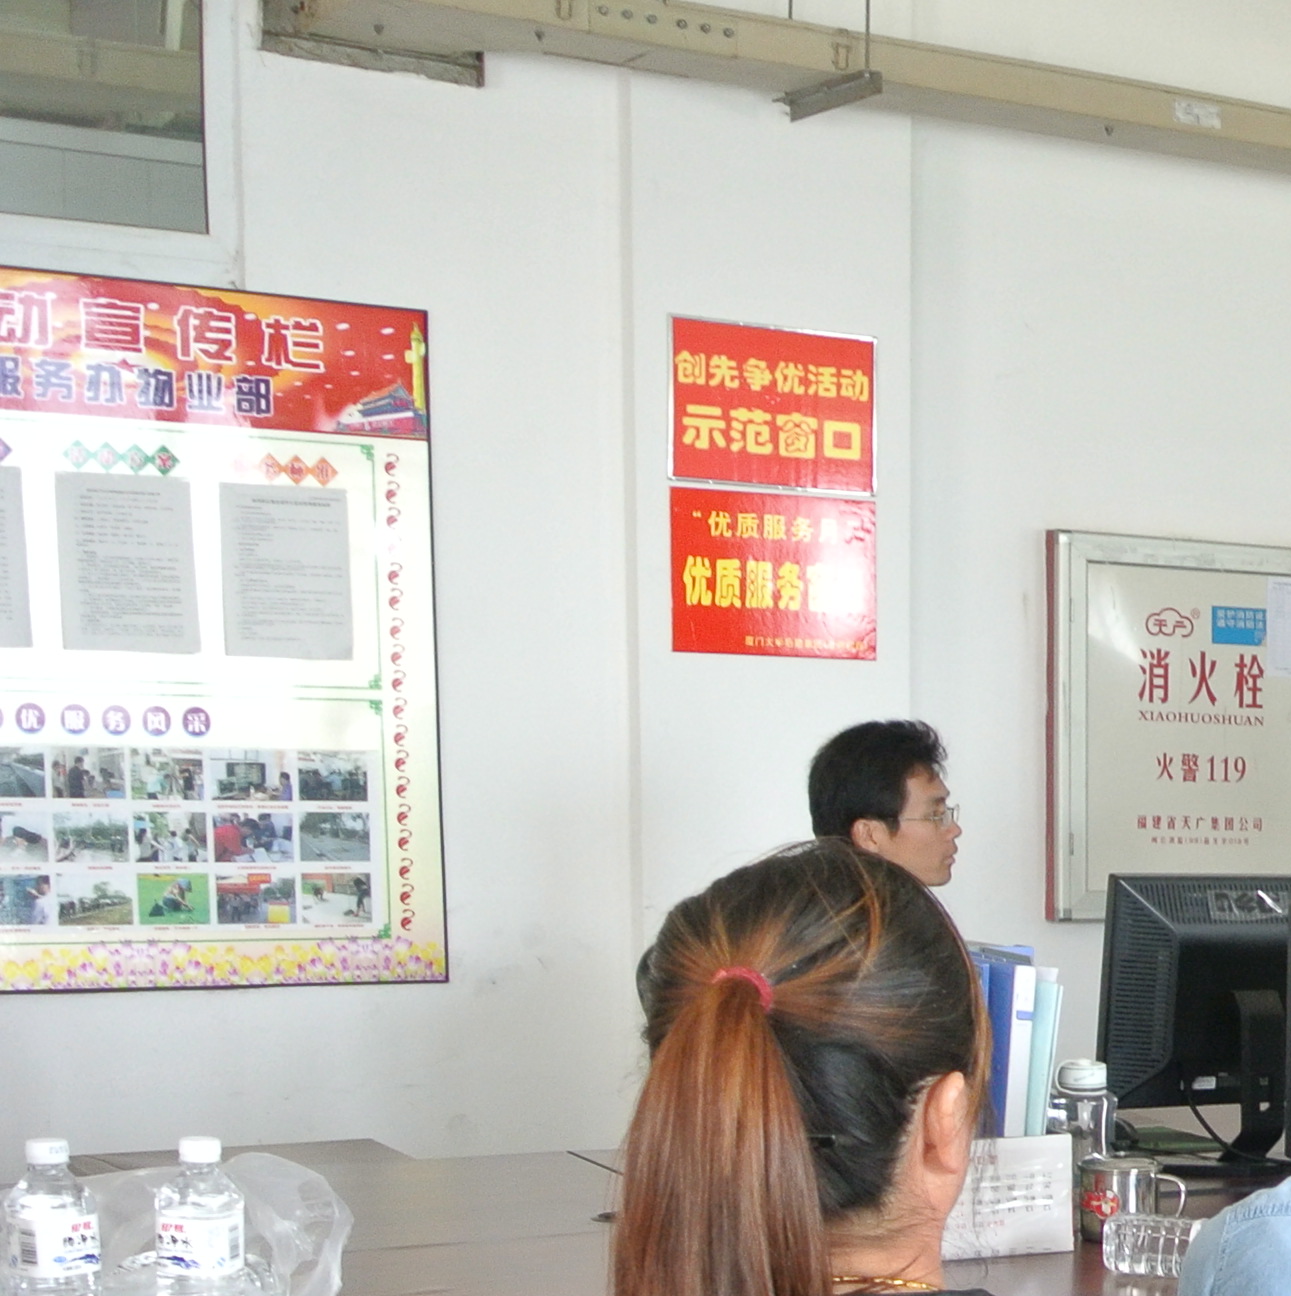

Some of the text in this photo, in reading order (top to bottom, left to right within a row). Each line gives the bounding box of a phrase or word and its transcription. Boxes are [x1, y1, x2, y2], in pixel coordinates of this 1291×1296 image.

[0, 291, 325, 373] 动宣传栏
[674, 350, 869, 402] 创先争优活动
[681, 403, 861, 461] 示范窗口
[682, 554, 864, 615] 优质服务
[1137, 647, 1264, 709] 消火栓
[1137, 710, 1264, 726] XIAOHUOSHUAN
[1136, 815, 1263, 832] 福建省天广集团公司
